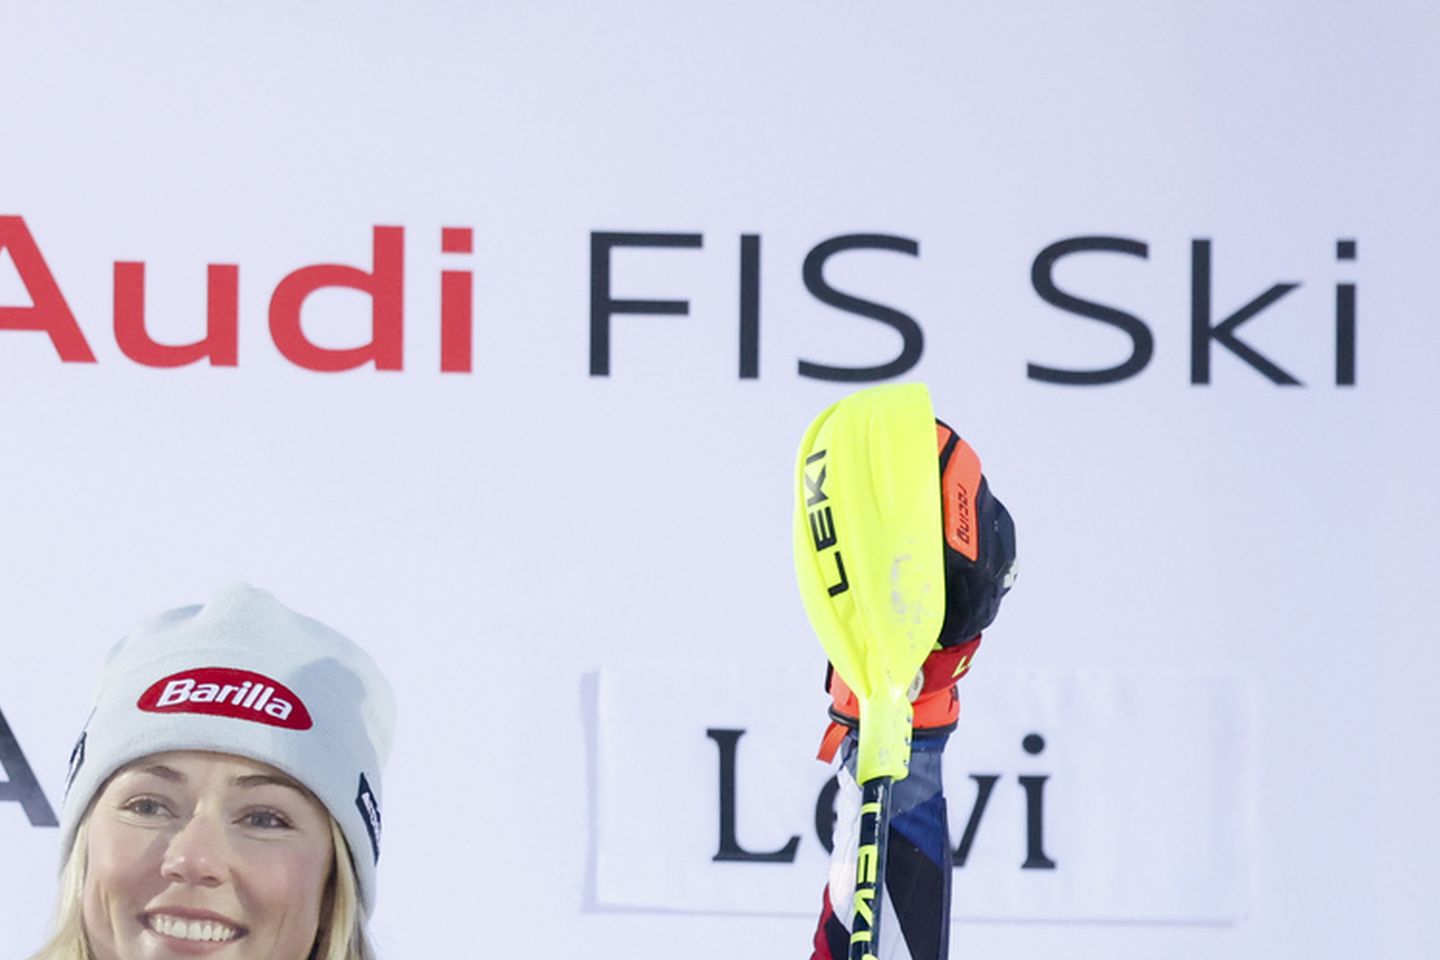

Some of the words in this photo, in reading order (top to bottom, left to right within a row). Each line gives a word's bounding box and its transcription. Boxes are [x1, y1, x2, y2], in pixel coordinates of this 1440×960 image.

[590, 232, 924, 383] FIS
[1027, 236, 1357, 386] Ski
[804, 448, 850, 598] LEKI
[155, 677, 294, 721] Barilla
